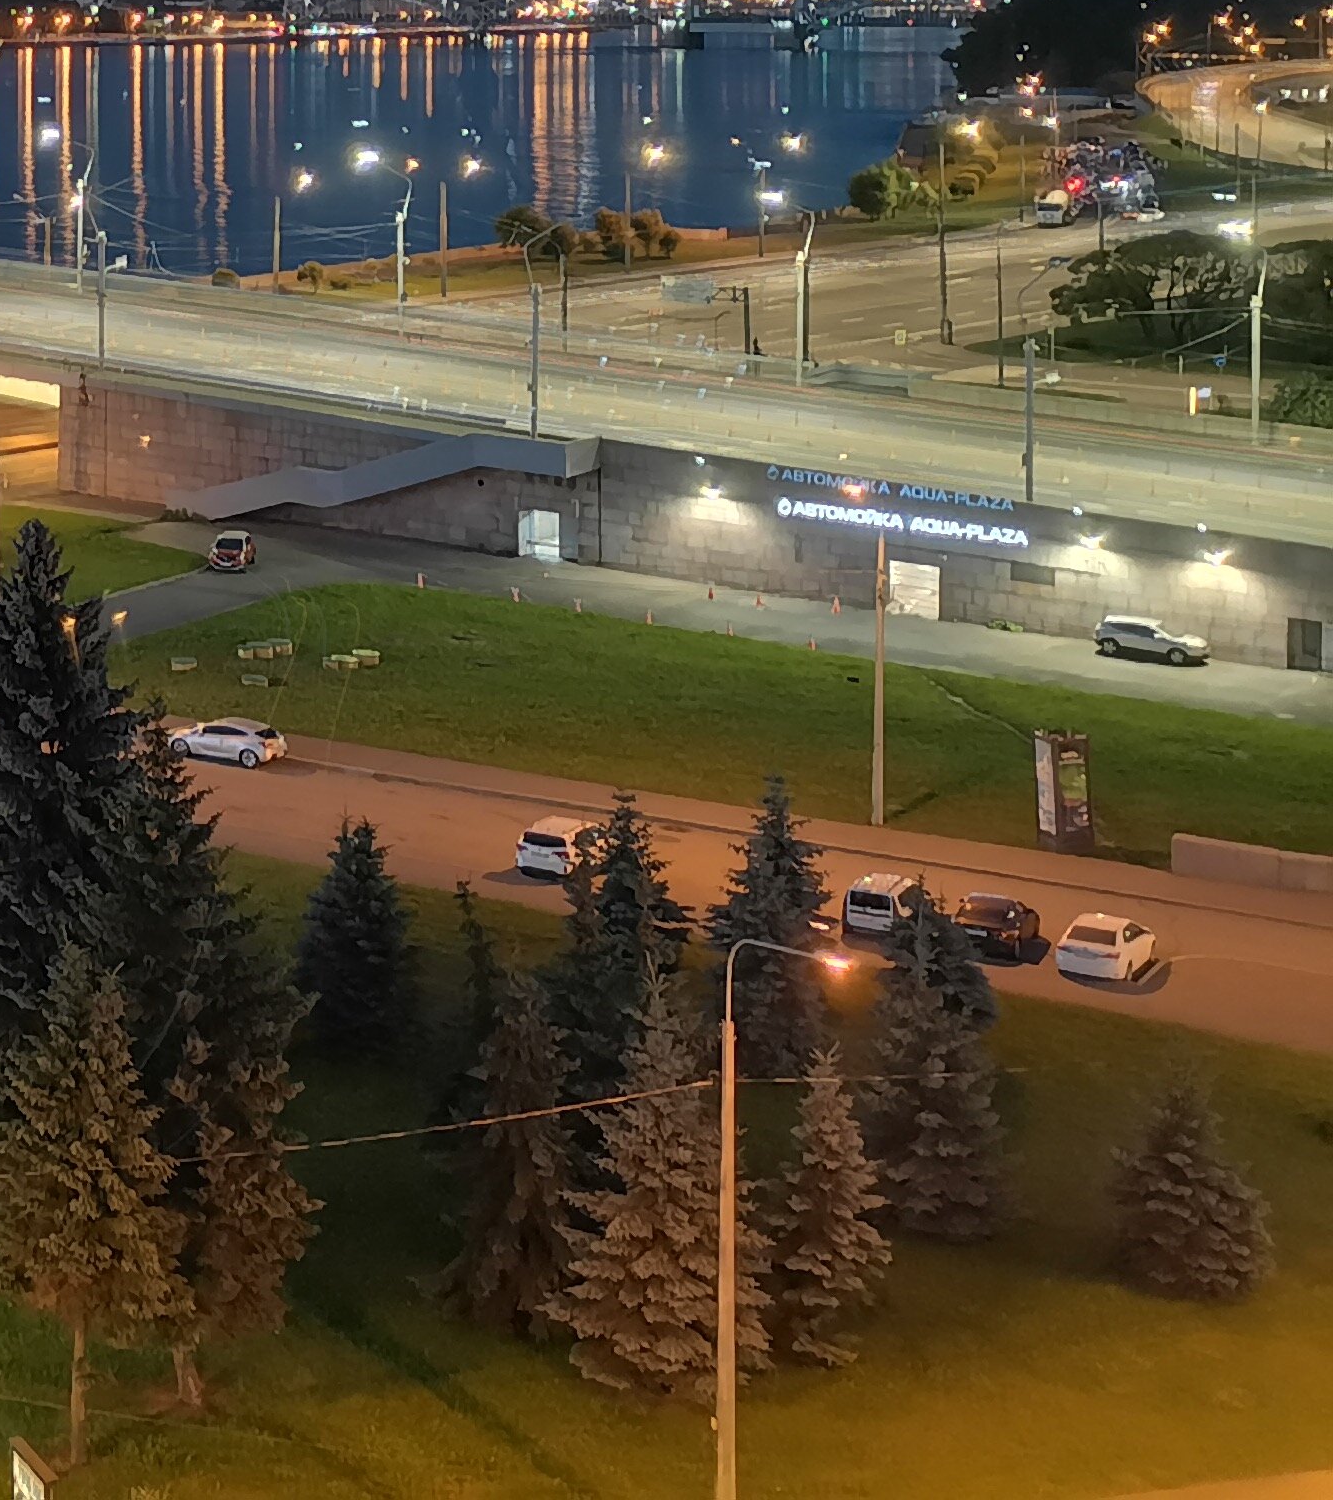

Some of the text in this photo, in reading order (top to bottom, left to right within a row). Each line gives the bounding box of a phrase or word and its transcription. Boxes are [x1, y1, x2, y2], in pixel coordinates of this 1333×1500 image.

[899, 483, 1014, 511] AQUA-PLAZA
[792, 500, 1029, 547] АВТОМОЙКА AQUA-PLAZA
